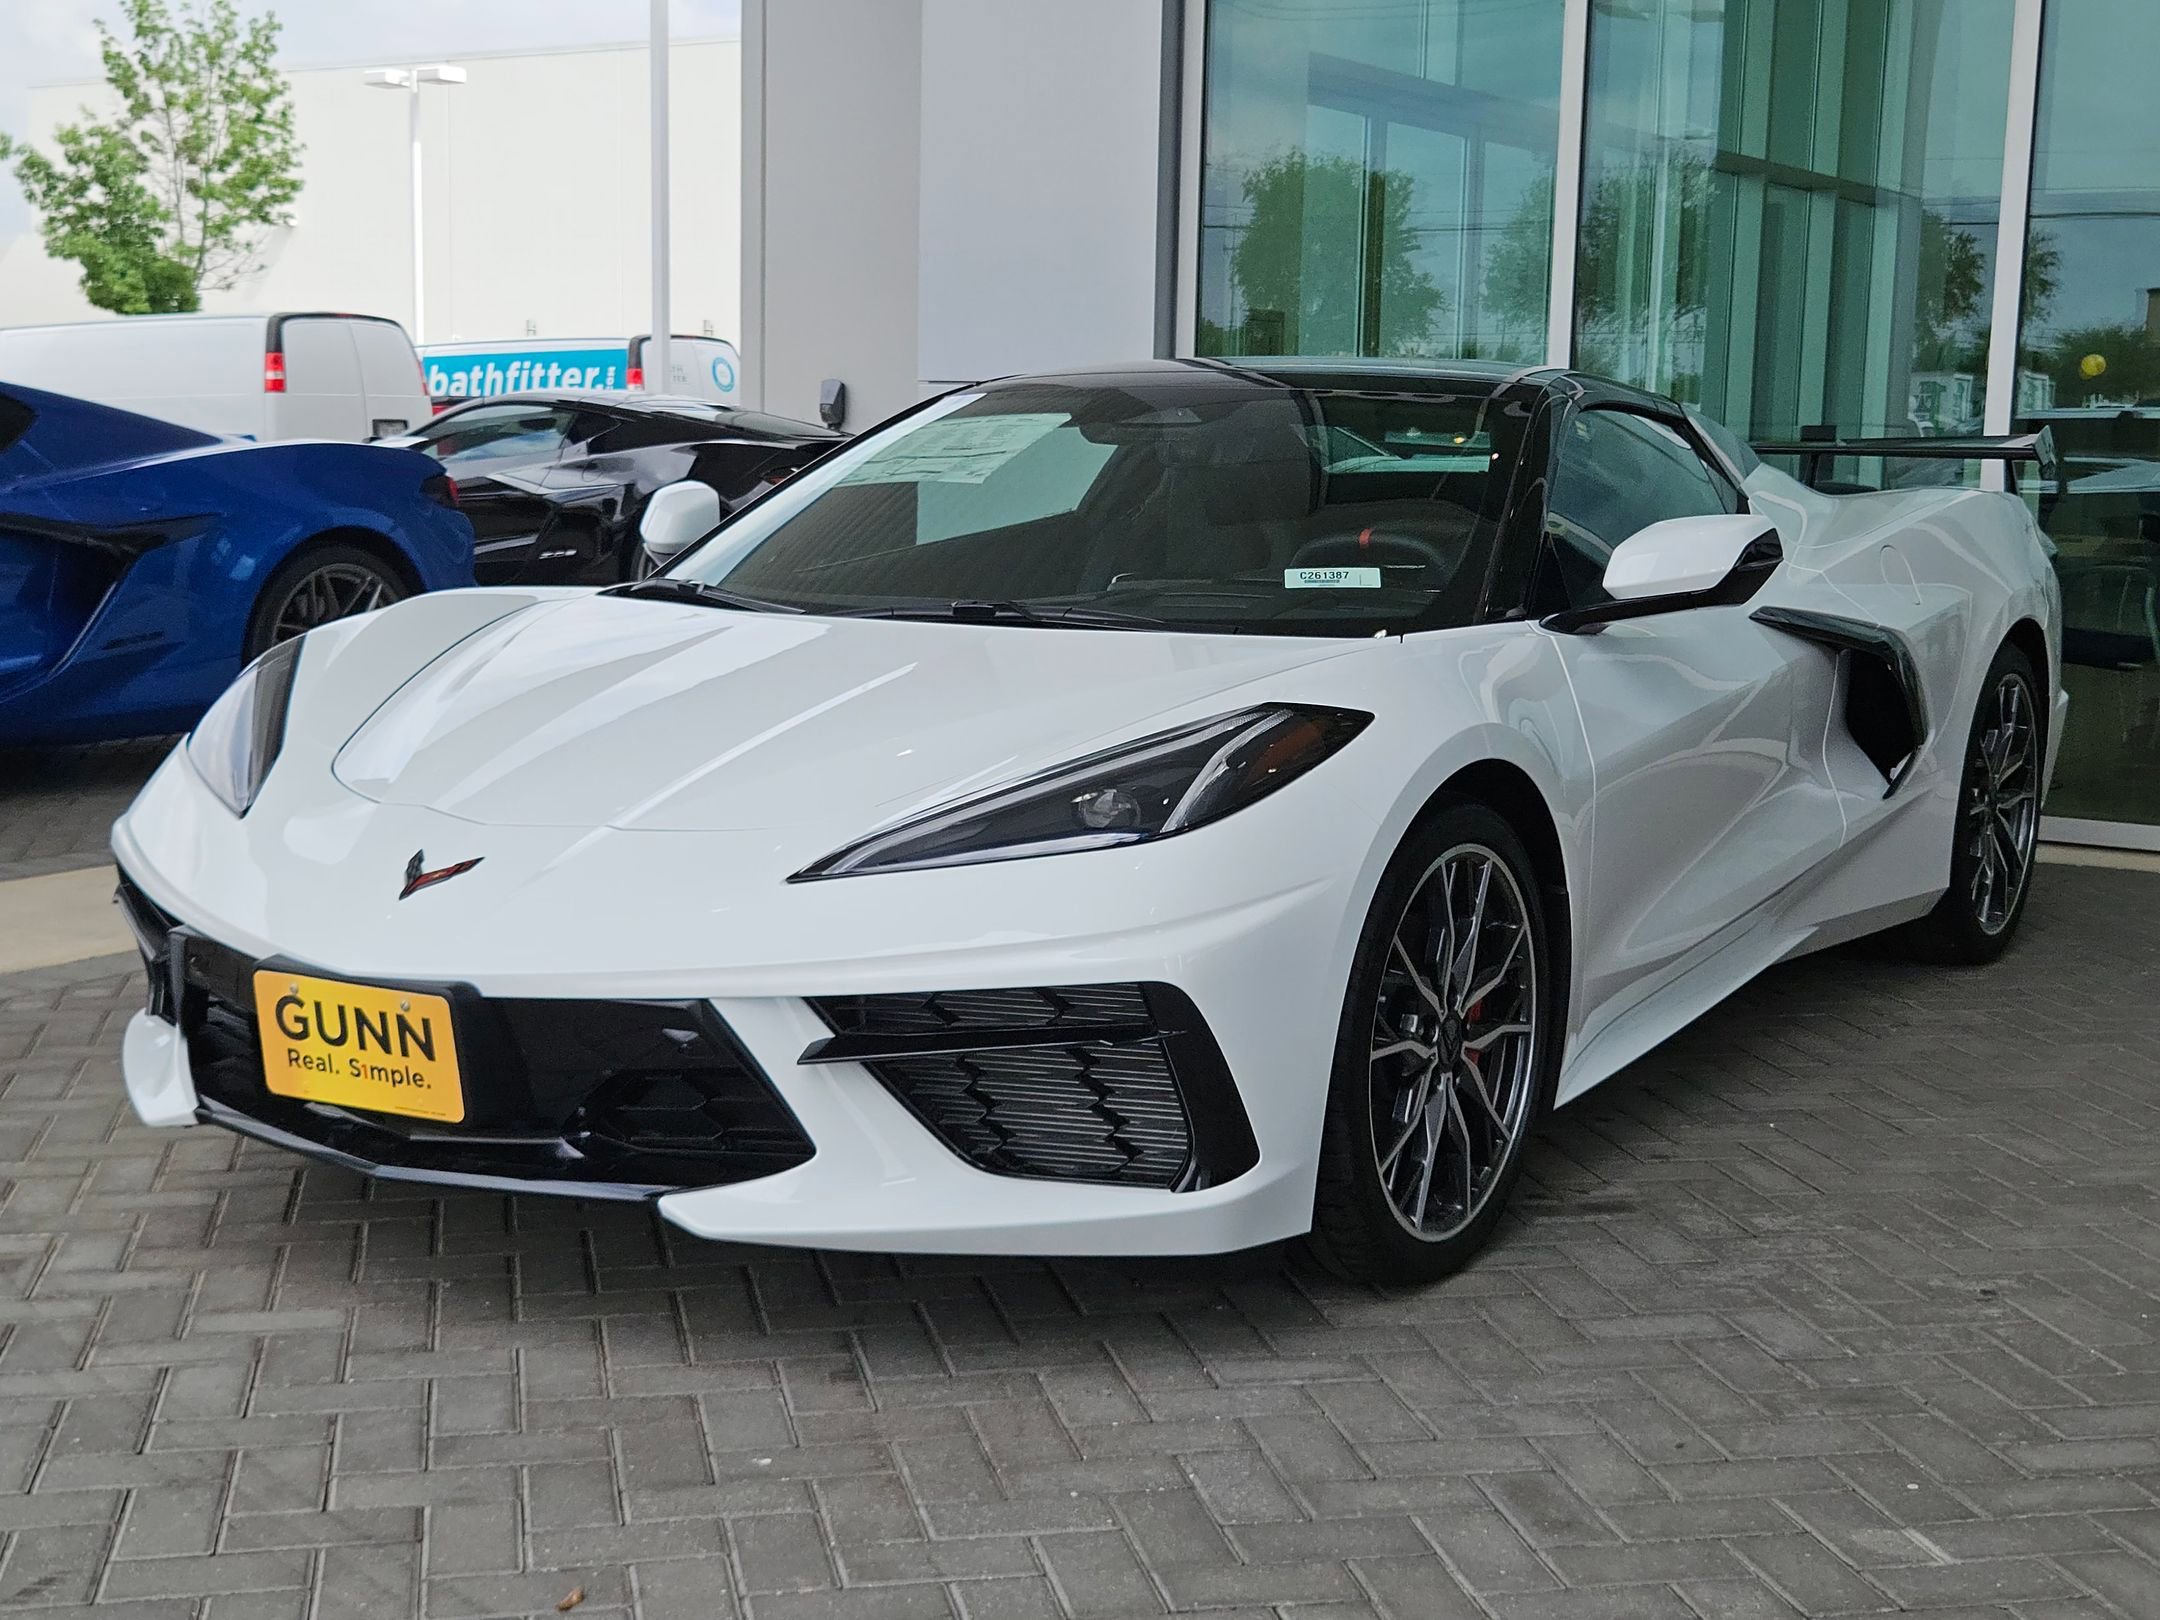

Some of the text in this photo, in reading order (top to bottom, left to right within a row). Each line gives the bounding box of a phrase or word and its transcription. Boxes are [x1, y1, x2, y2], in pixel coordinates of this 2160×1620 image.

[1300, 571, 1349, 580] C261387
[275, 995, 436, 1062] GUNN
[287, 1047, 340, 1075] Real.
